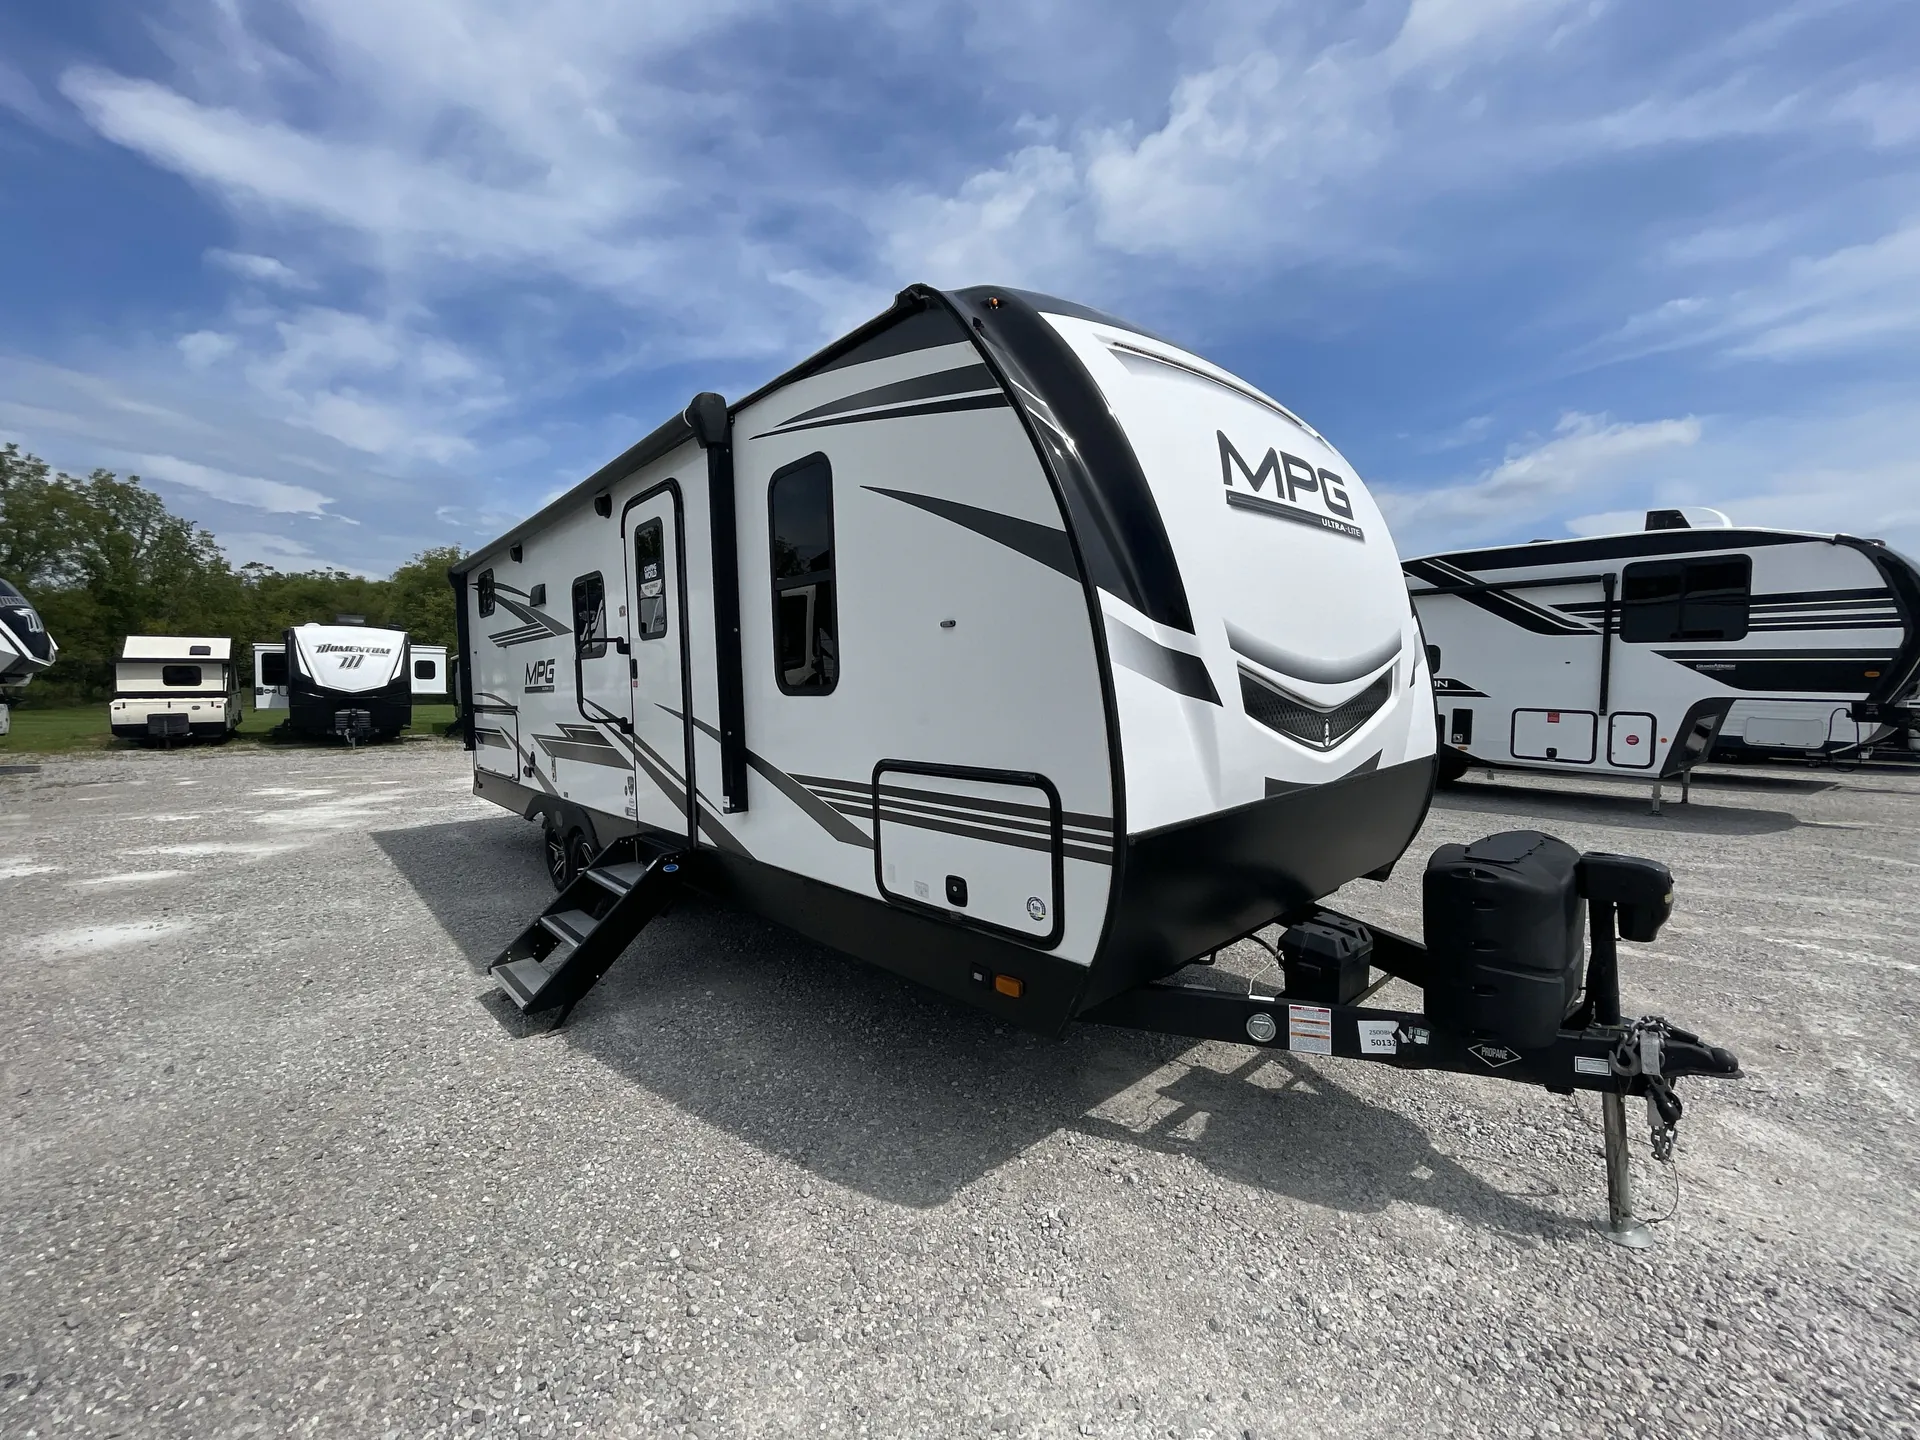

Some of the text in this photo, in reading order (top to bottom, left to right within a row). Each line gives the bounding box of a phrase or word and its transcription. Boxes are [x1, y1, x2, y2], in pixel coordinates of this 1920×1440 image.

[1216, 429, 1355, 521] MPG
[1321, 517, 1361, 537] ULTRA-LITE
[314, 643, 392, 655] MOMENTUM
[524, 658, 555, 685] MPG
[1481, 1046, 1508, 1060] PROPANE
